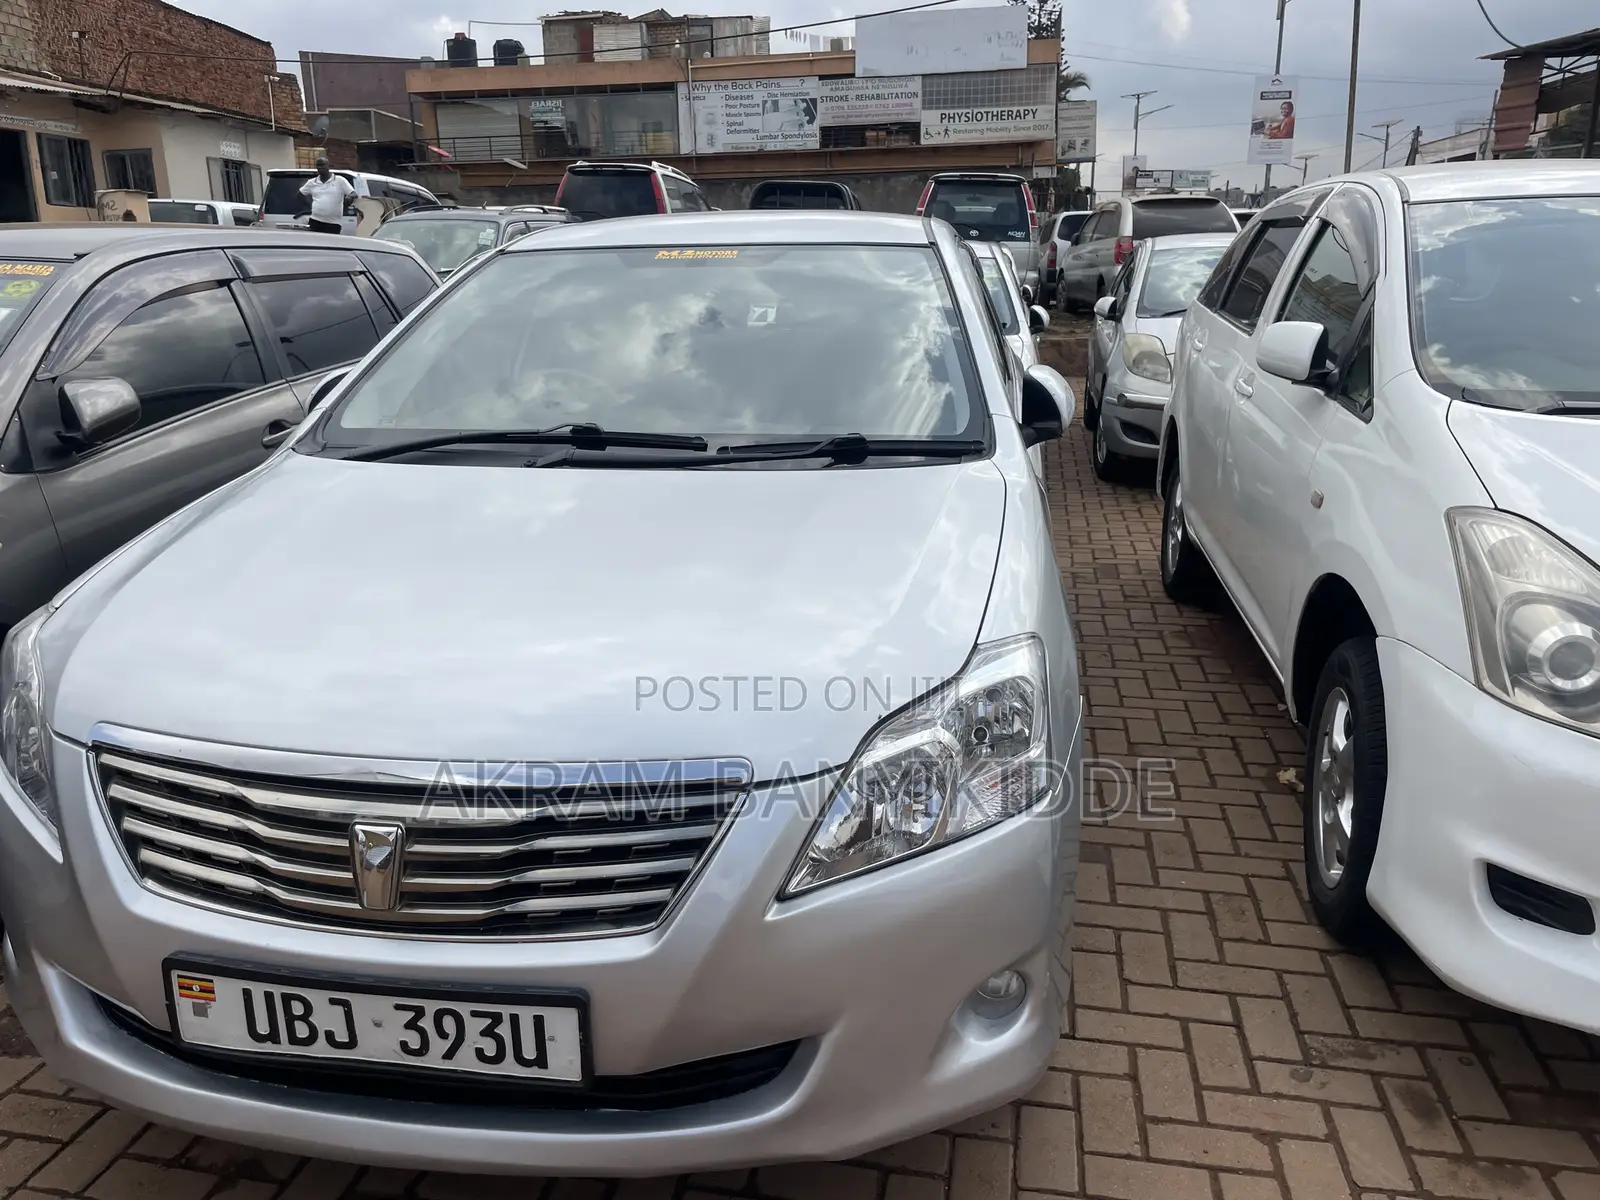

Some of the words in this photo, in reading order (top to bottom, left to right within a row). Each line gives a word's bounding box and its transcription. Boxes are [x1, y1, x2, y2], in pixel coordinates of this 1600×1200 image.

[691, 83, 711, 93] Why
[714, 81, 729, 91] the
[731, 81, 754, 90] Back
[724, 93, 754, 101] Diseases
[819, 94, 849, 104] STROKE
[855, 91, 919, 102] REHABILITATION
[952, 127, 985, 136] Restoring
[985, 125, 1011, 134] Mobility
[1012, 124, 1031, 132] Since
[1032, 123, 1049, 131] 2017
[755, 133, 780, 141] Lumbar
[780, 132, 818, 140] Spondylosis
[242, 986, 359, 1051] UBJ
[393, 1002, 550, 1070] 393U
